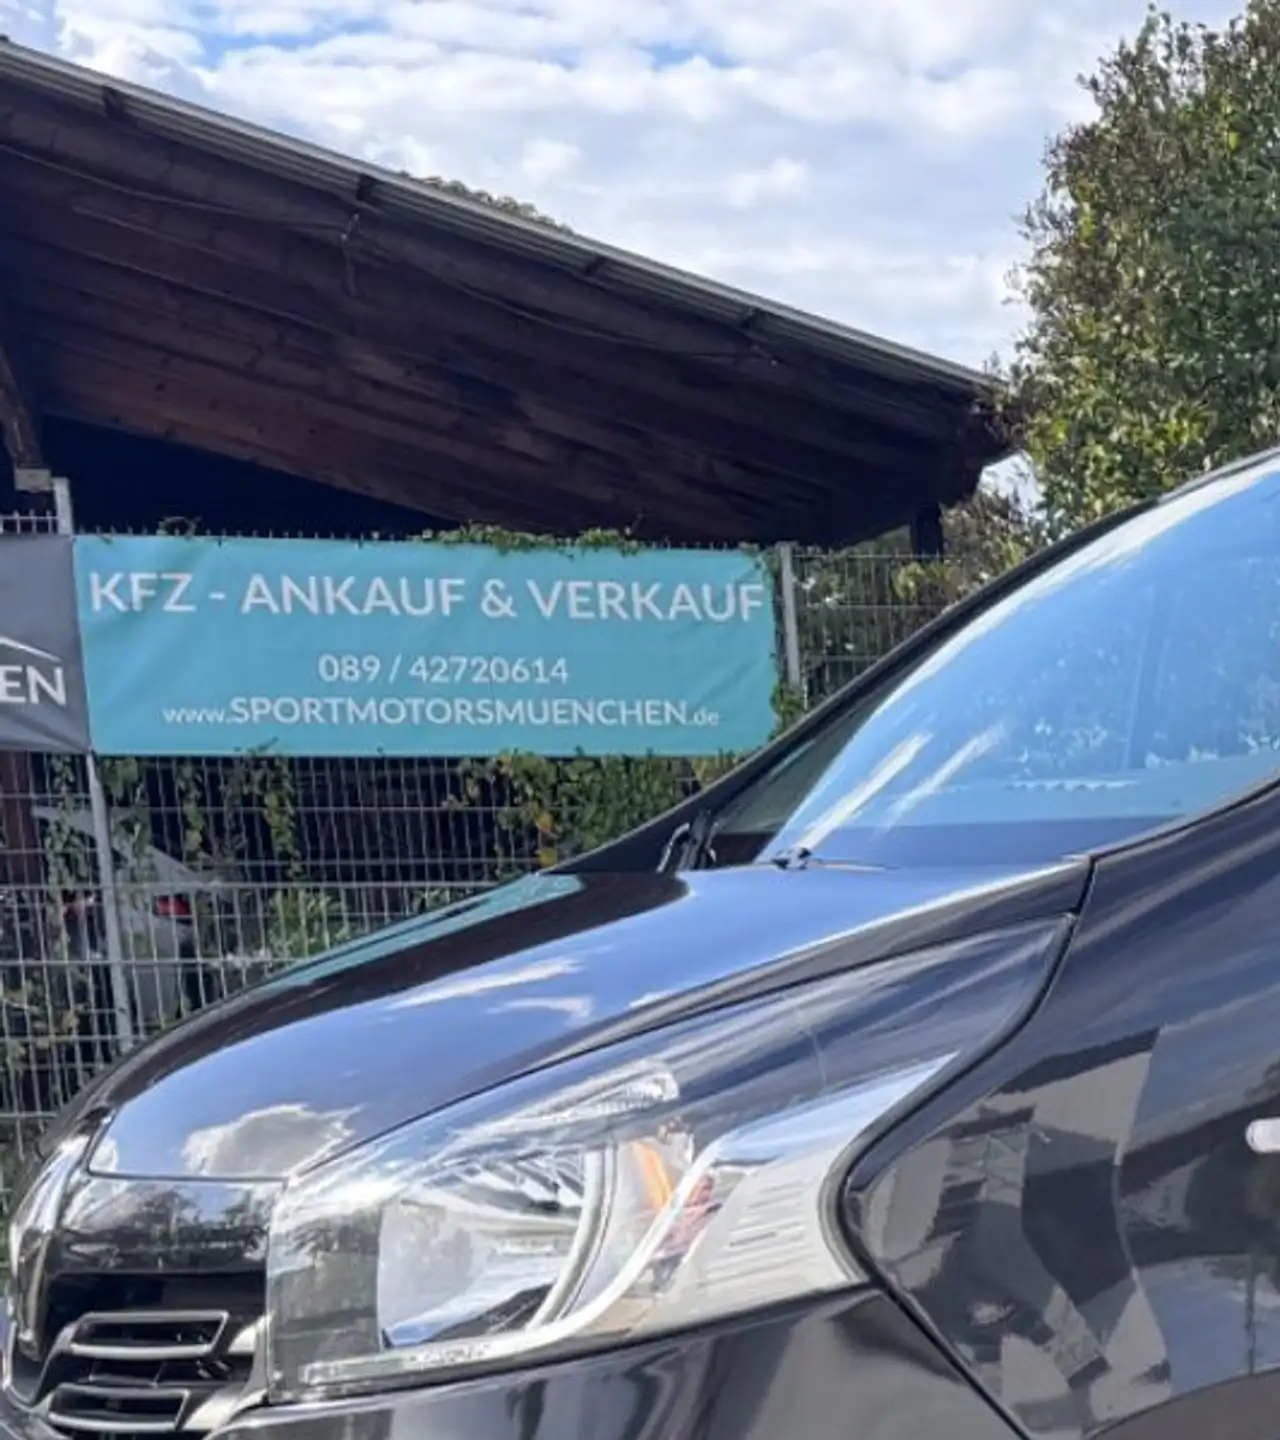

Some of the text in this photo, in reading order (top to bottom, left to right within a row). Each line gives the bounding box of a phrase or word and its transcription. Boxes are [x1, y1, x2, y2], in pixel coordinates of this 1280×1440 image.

[89, 571, 764, 622] KFZ - ANKAUF & VERKAUF
[318, 653, 569, 685] 089 / 42720614
[163, 697, 720, 727] www.SPORTMOTORSMUENCHEN.de
